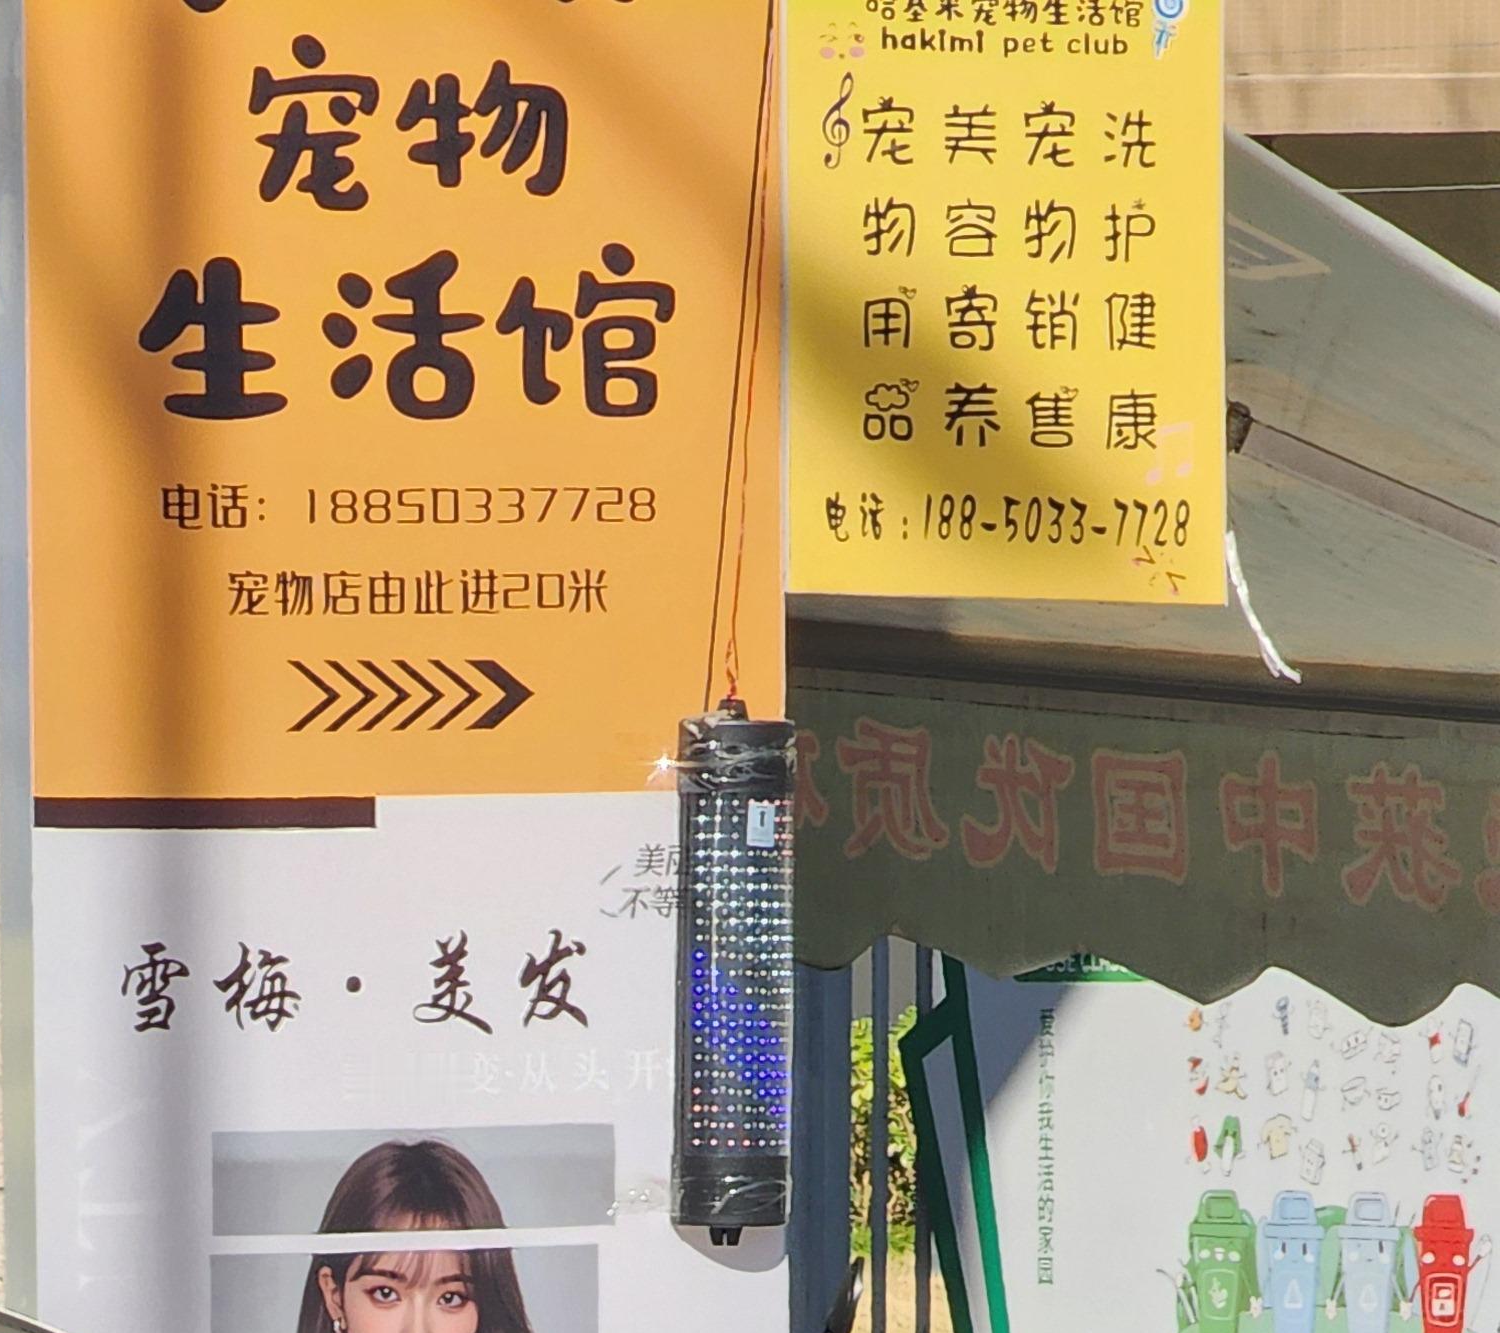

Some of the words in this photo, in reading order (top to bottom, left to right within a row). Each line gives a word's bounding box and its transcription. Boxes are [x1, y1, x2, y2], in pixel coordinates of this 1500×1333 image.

[881, 27, 984, 52] hakimi
[1003, 33, 1054, 58] pet
[1067, 33, 1128, 55] club
[249, 34, 568, 211] 宠物
[138, 243, 676, 420] 生活馆
[305, 486, 658, 525] 18850337728
[923, 493, 1191, 548] 188-5033-7728
[227, 570, 608, 617] 宠物店由此进20米
